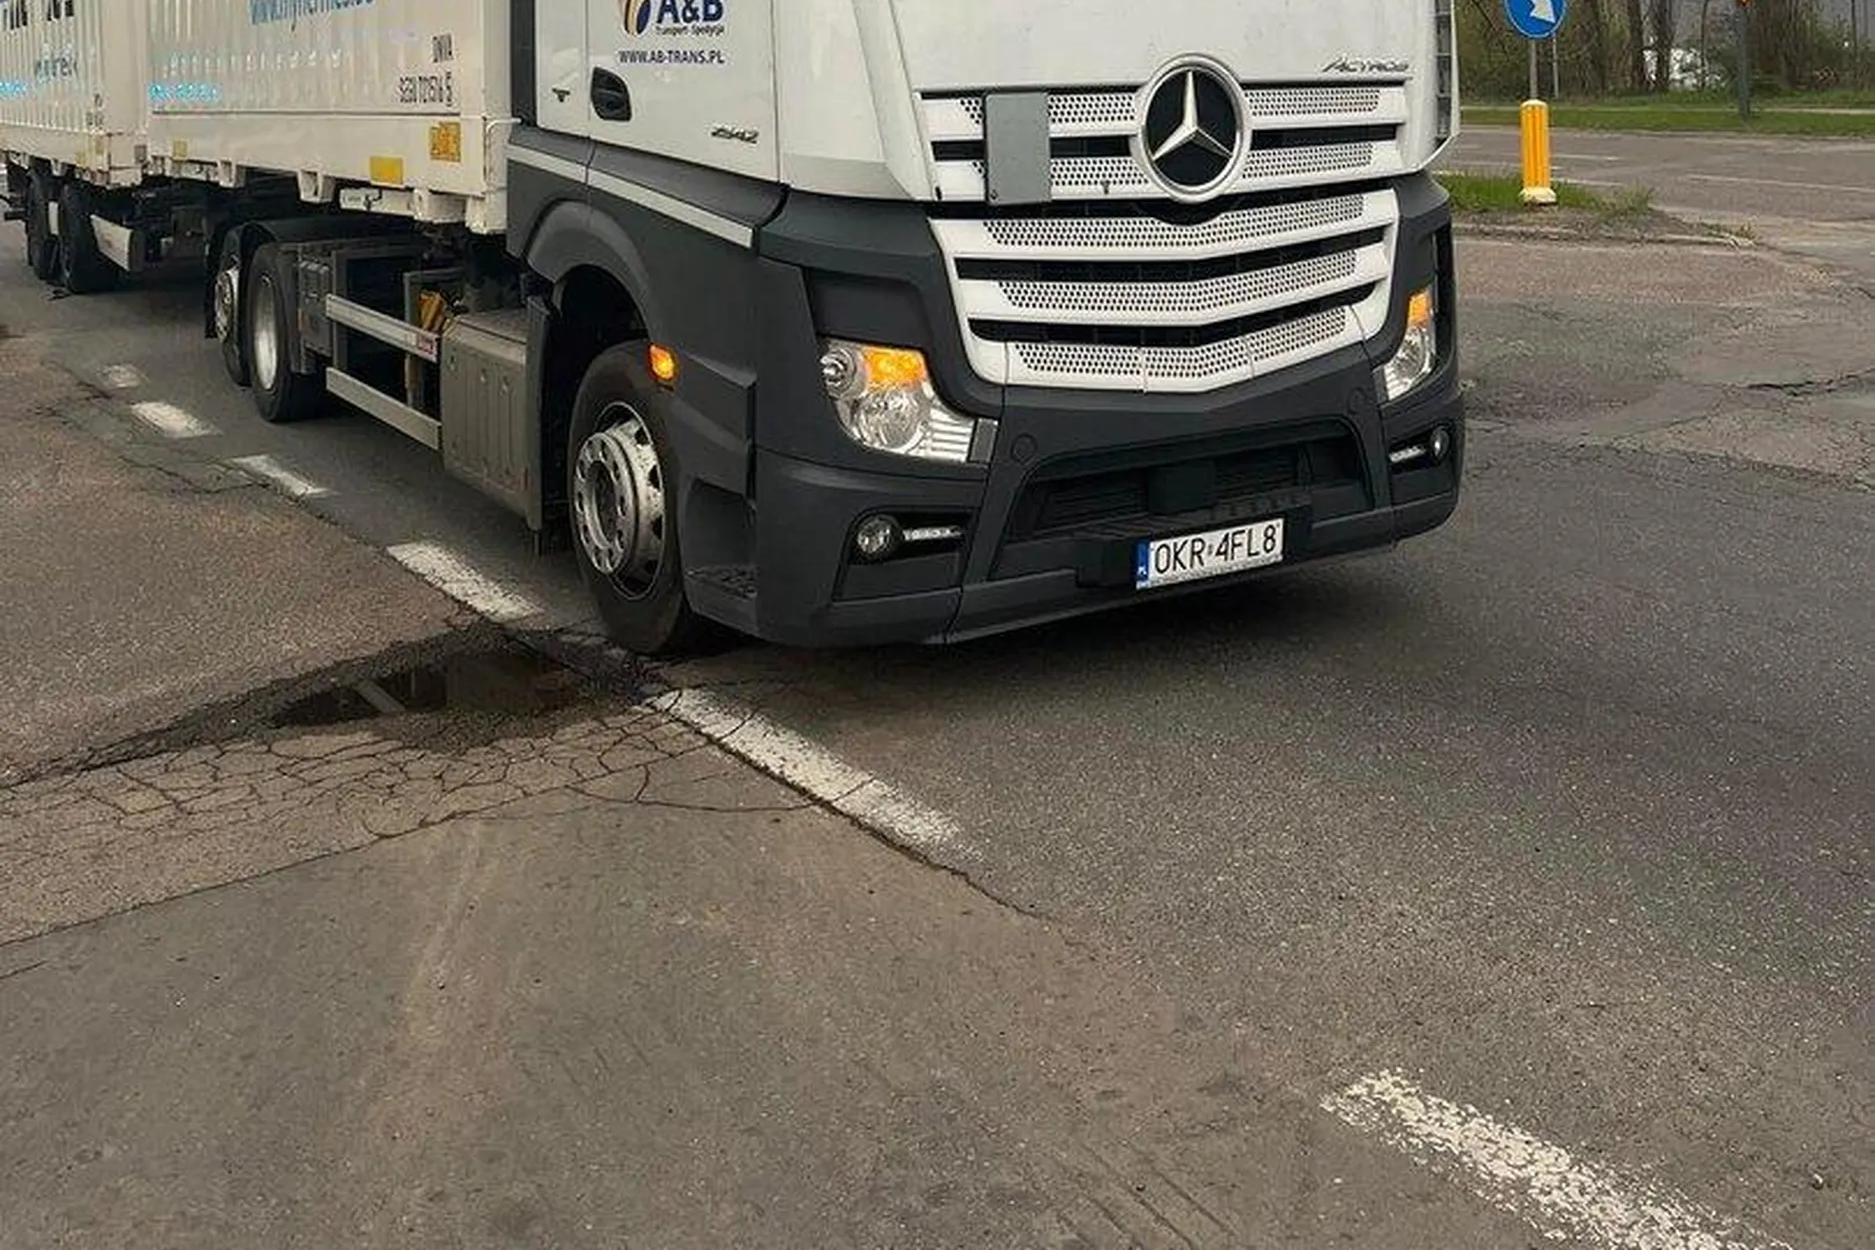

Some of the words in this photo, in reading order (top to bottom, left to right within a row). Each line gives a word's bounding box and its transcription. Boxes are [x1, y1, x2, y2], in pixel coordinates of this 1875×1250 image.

[618, 49, 725, 64] WWW.AB-TRANS.PL
[1154, 537, 1206, 575] OKR
[1215, 523, 1277, 563] 4FL8
